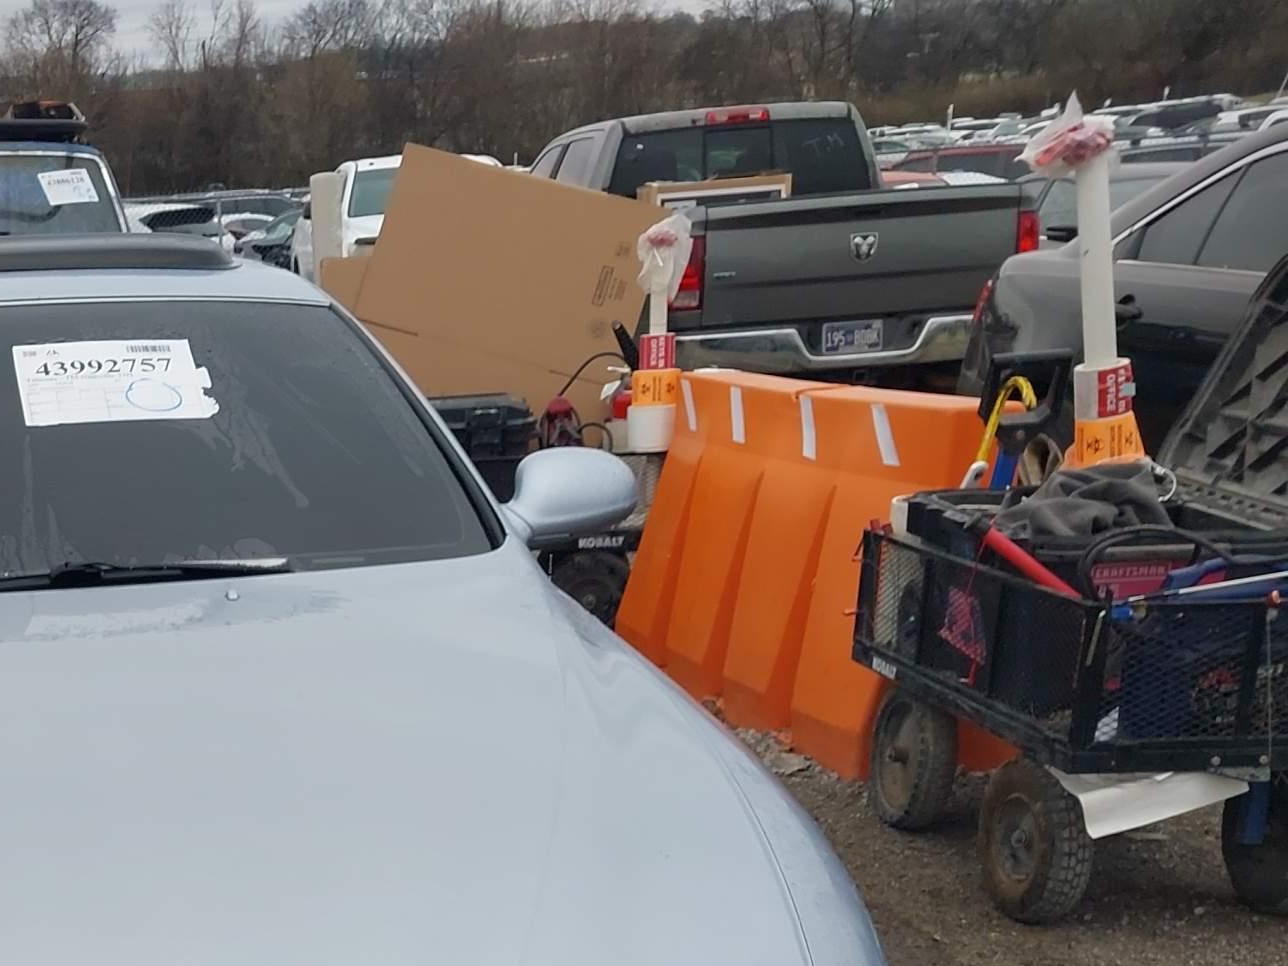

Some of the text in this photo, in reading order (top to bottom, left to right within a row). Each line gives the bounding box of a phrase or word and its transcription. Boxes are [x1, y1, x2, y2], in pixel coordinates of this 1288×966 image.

[35, 357, 172, 376] 43992757
[1106, 374, 1116, 413] OFFICE
[578, 535, 625, 549] KOBALT
